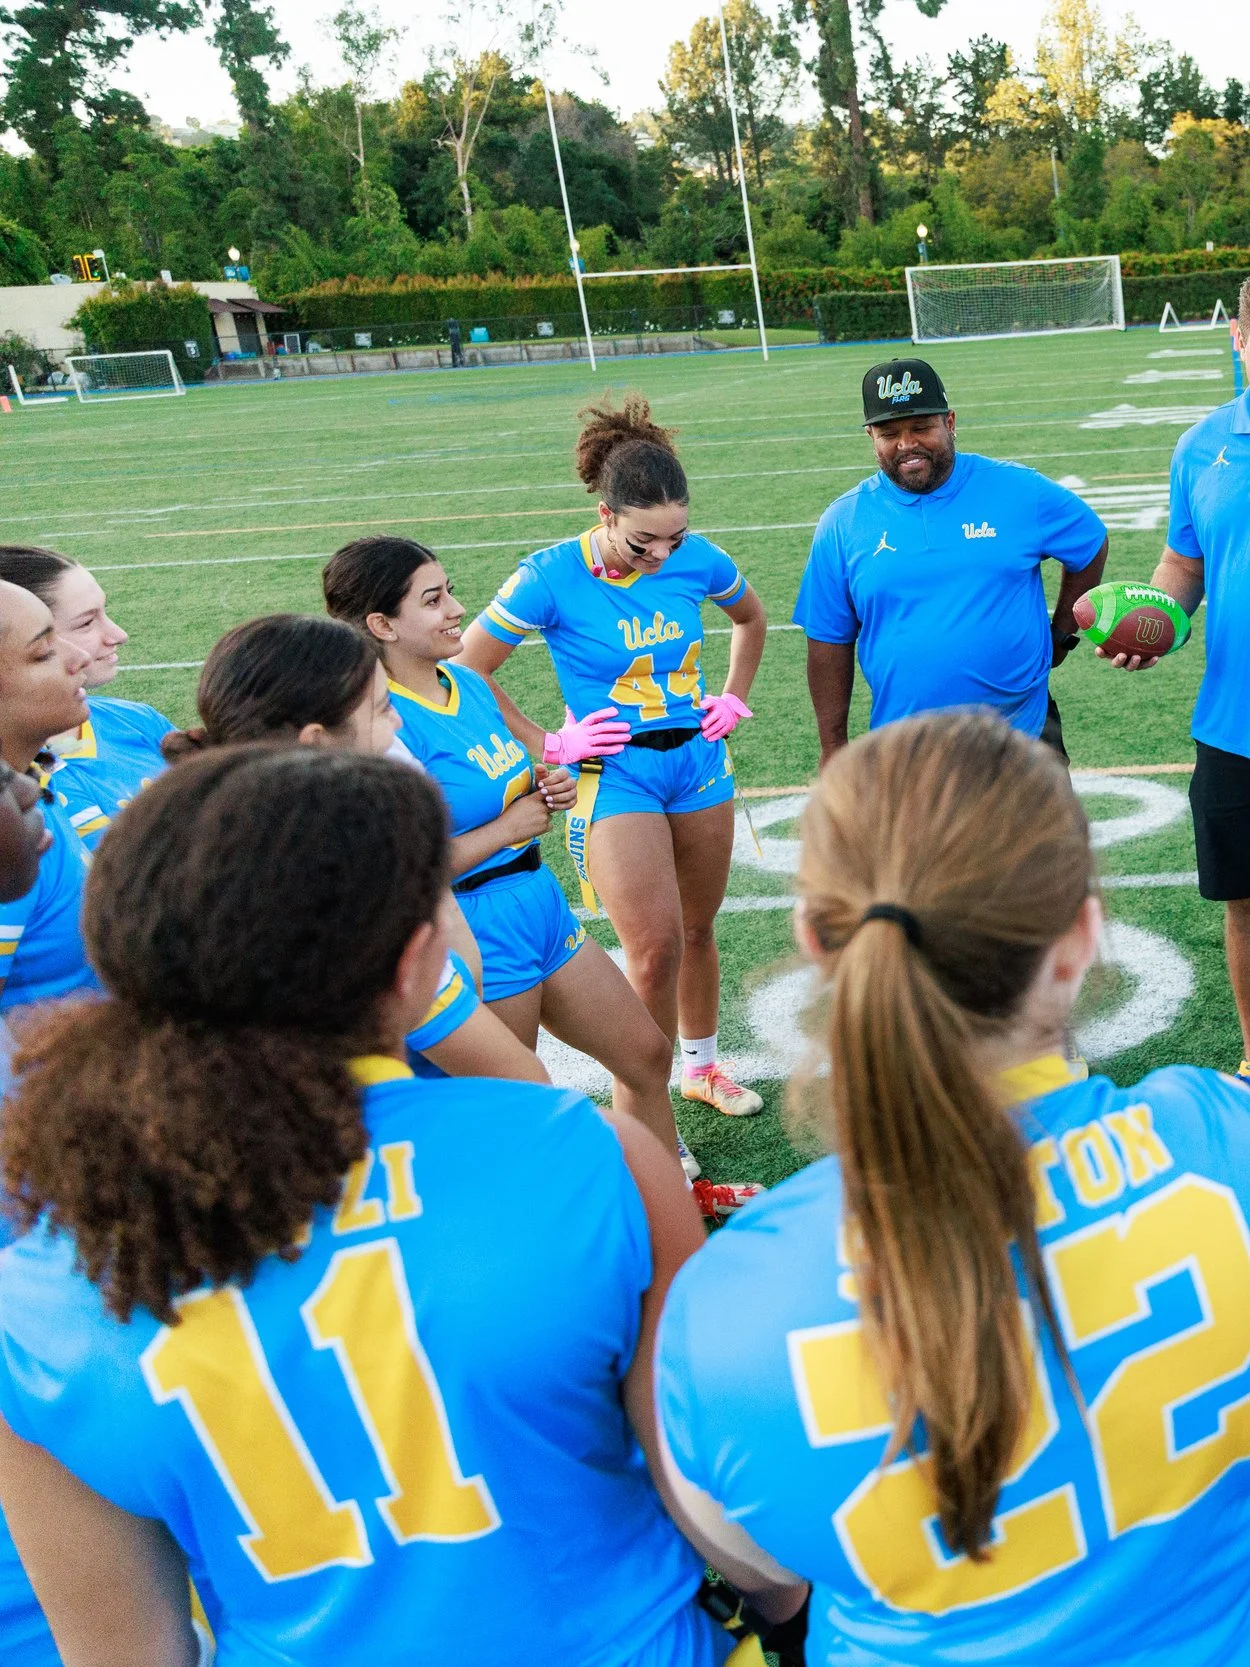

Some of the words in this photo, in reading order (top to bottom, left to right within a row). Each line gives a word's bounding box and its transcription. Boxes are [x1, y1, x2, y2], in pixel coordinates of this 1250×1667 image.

[877, 371, 922, 400] Ucla
[961, 521, 997, 540] Ucla
[617, 611, 684, 651] Ucla
[608, 638, 702, 722] 44
[467, 733, 525, 780] Ucla
[139, 1236, 503, 1585] 11
